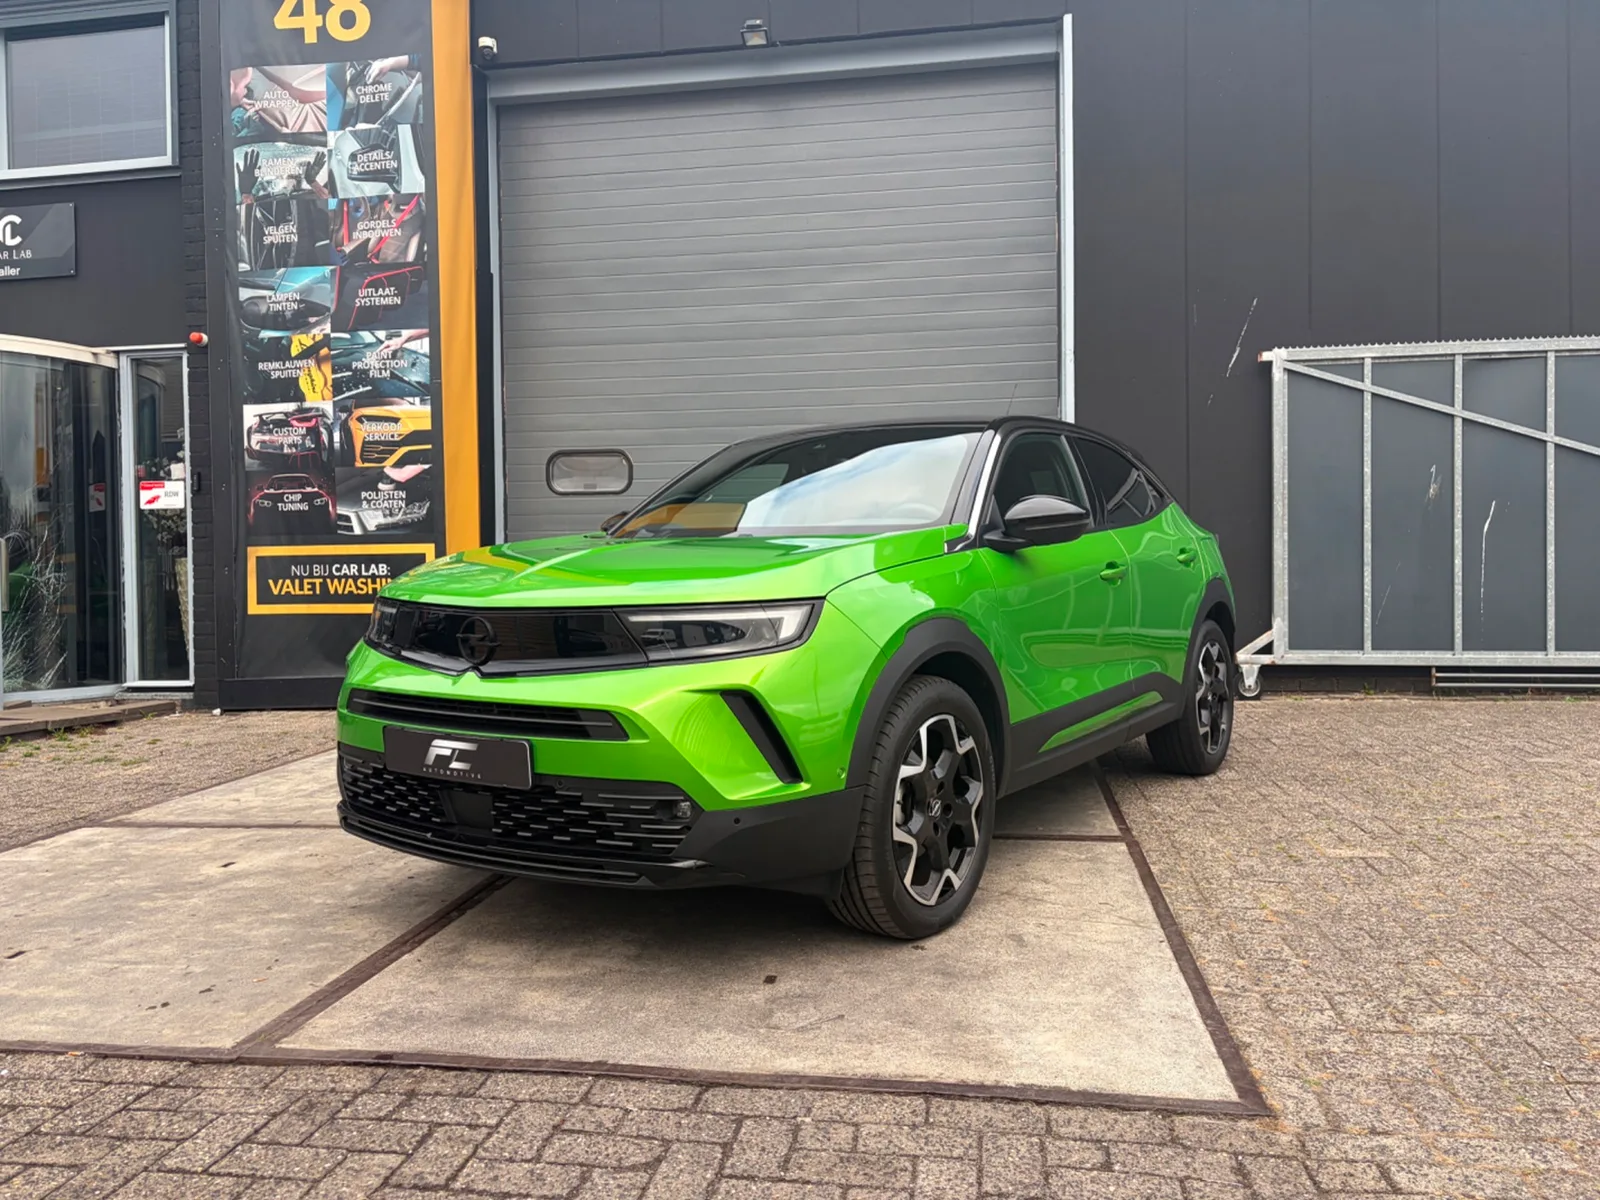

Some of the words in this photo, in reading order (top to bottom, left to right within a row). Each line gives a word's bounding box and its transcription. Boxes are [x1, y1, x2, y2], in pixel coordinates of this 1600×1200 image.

[273, 0, 371, 43] 48
[355, 83, 393, 95] CHROME
[263, 90, 290, 99] AUTO
[359, 92, 390, 104] DELETE
[254, 99, 300, 109] WRAPPEN
[357, 150, 394, 162] DETAILS/
[353, 159, 398, 172] ACCENTEN
[356, 219, 397, 230] GORDELS
[263, 225, 297, 235] VELGEN
[352, 228, 402, 240] INBOUWEN
[263, 234, 298, 244] SPUITEN
[13, 249, 32, 260] LAB
[266, 292, 300, 303] LAMPEN
[358, 287, 398, 298] UITLAAT-
[355, 296, 401, 307] SYSTEMEN
[269, 302, 298, 312] TINTEN
[366, 351, 393, 360] PAINT
[258, 359, 315, 371] REMKLAUWEN
[352, 360, 408, 370] PROTECTION
[271, 369, 303, 379] SPUITEN
[369, 369, 391, 379] FILM
[273, 427, 307, 437] CUSTOM
[364, 432, 400, 442] SERVICE
[278, 436, 303, 445] PARTS
[283, 493, 303, 502] CHIP
[361, 490, 407, 500] POLIJSTEN
[277, 502, 309, 512] TUNING
[361, 500, 370, 509] &
[370, 499, 406, 509] COATEN
[291, 564, 310, 577] NU
[312, 564, 330, 577] BIJ
[332, 563, 359, 576] CAR
[361, 563, 391, 576] LAB:
[268, 578, 323, 596] VALET
